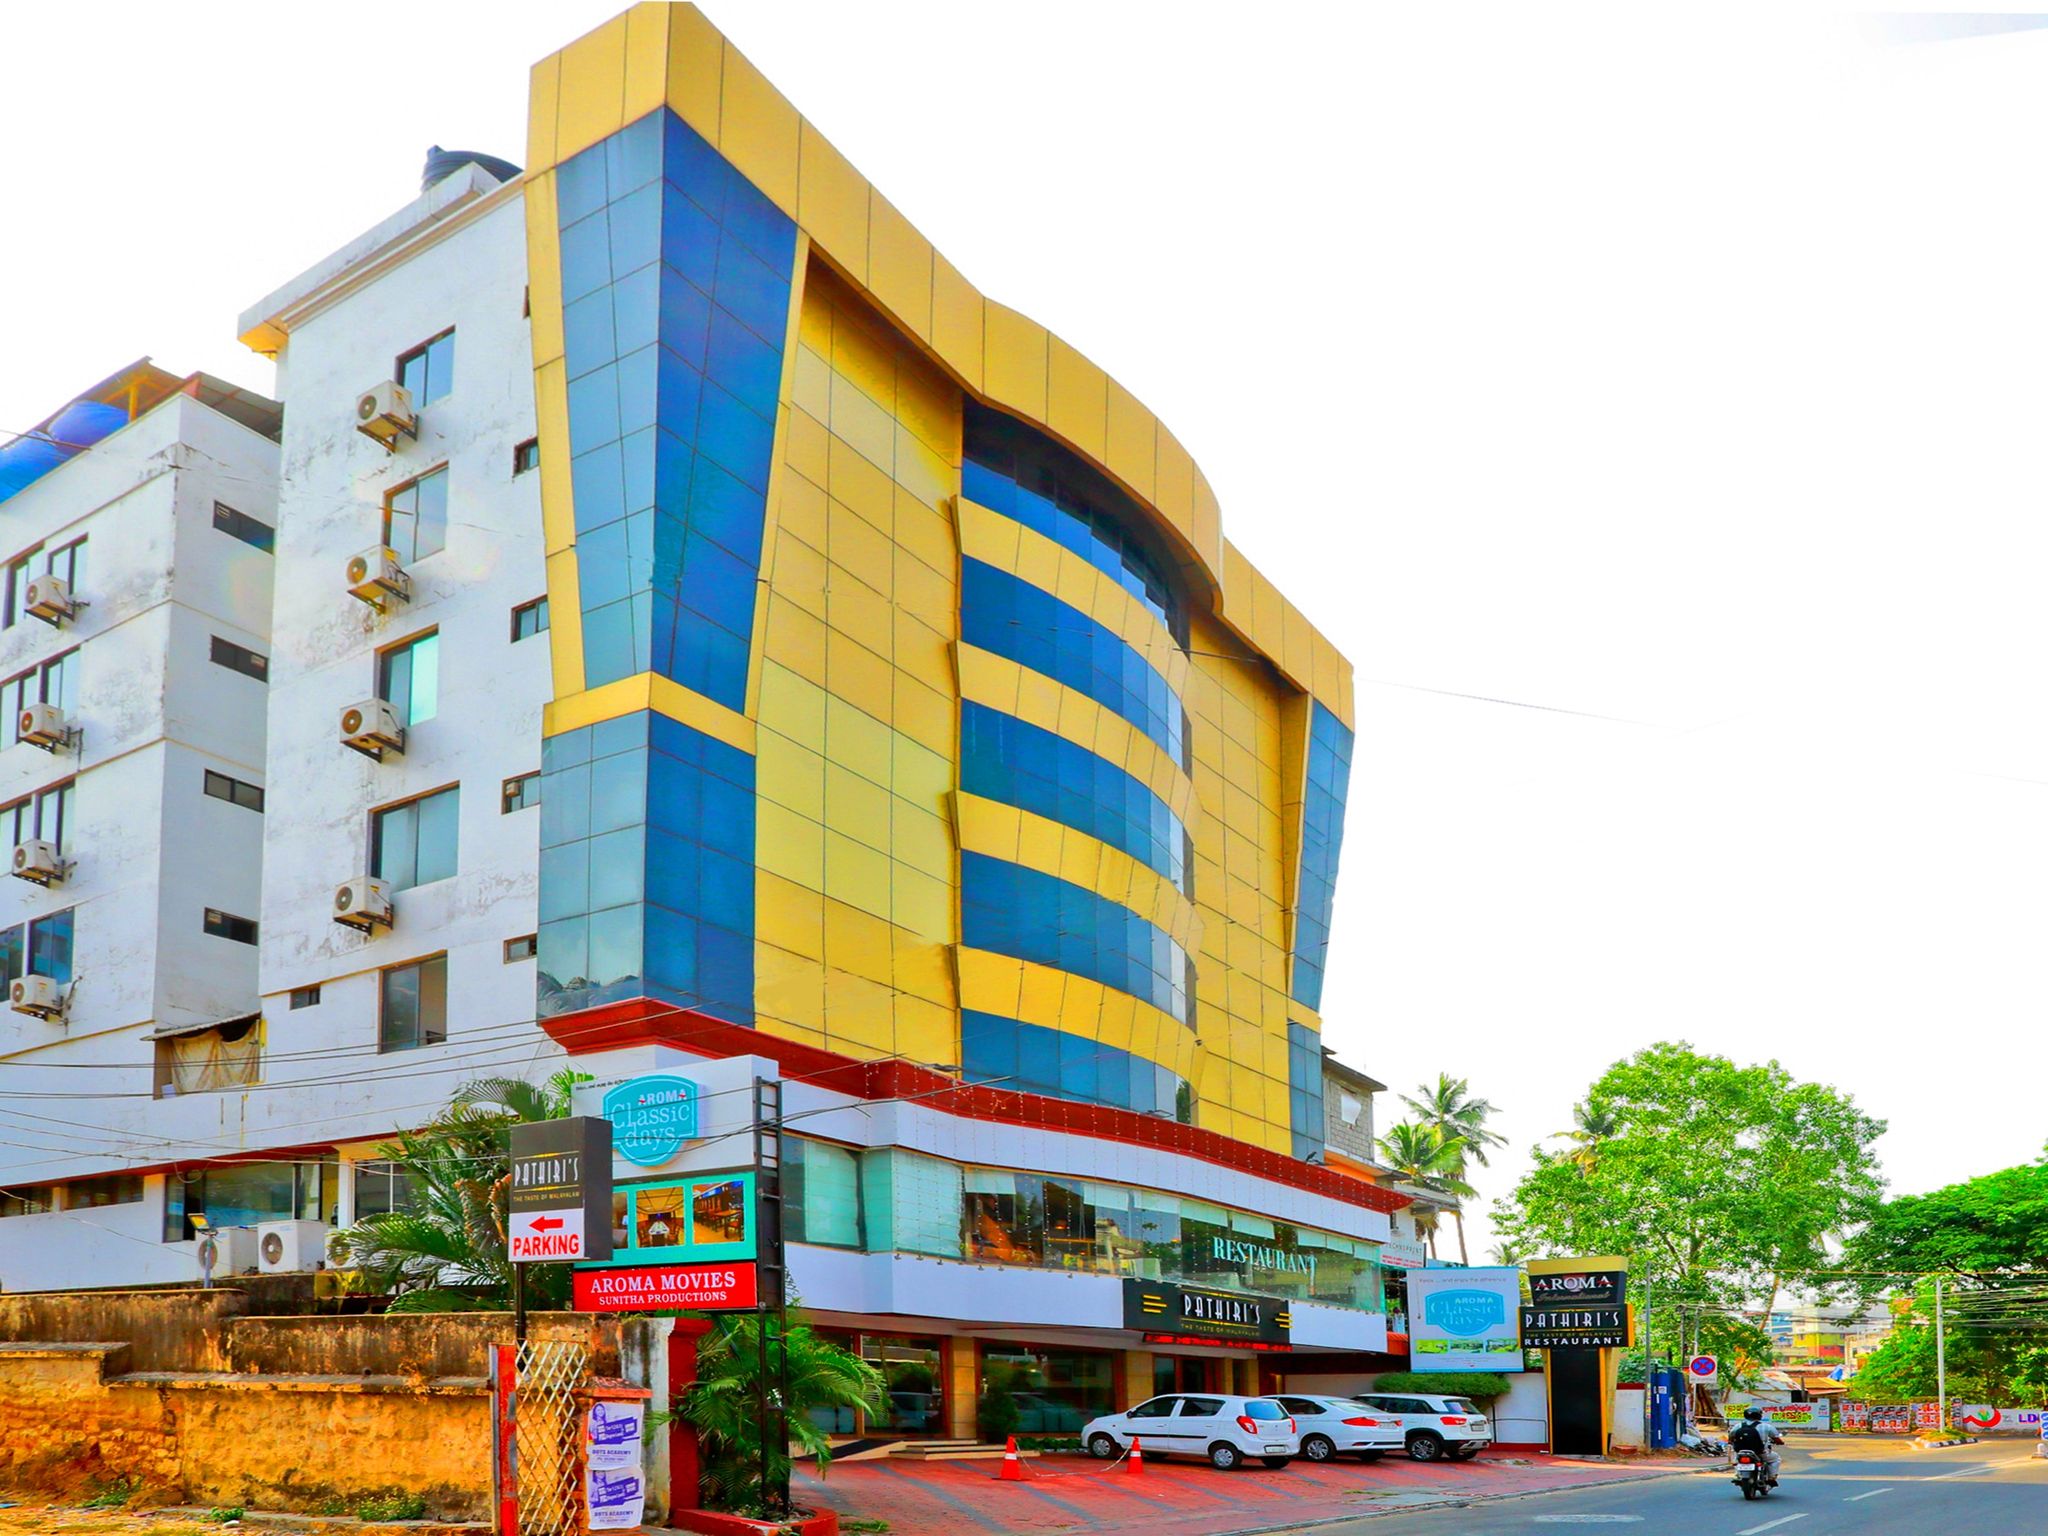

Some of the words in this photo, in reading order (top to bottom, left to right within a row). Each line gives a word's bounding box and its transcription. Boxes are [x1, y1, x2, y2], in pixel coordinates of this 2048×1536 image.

[638, 1088, 687, 1106] AROMA
[611, 1102, 690, 1129] Classic
[514, 1158, 579, 1187] PATHIRI'S
[513, 1233, 580, 1257] PARKING
[1212, 1236, 1318, 1275] RESTAURANT
[591, 1273, 655, 1294] AROMA
[661, 1271, 736, 1290] MOVIES
[1535, 1275, 1613, 1291] AROMA
[599, 1295, 645, 1306] SUNITHA
[647, 1291, 727, 1303] PRODUCTIONS
[1431, 1301, 1497, 1315] Classic
[1184, 1294, 1261, 1324] PATHIRI'S
[1525, 1312, 1619, 1328] PATHIRI'S
[1525, 1337, 1622, 1345] RESTAURANT
